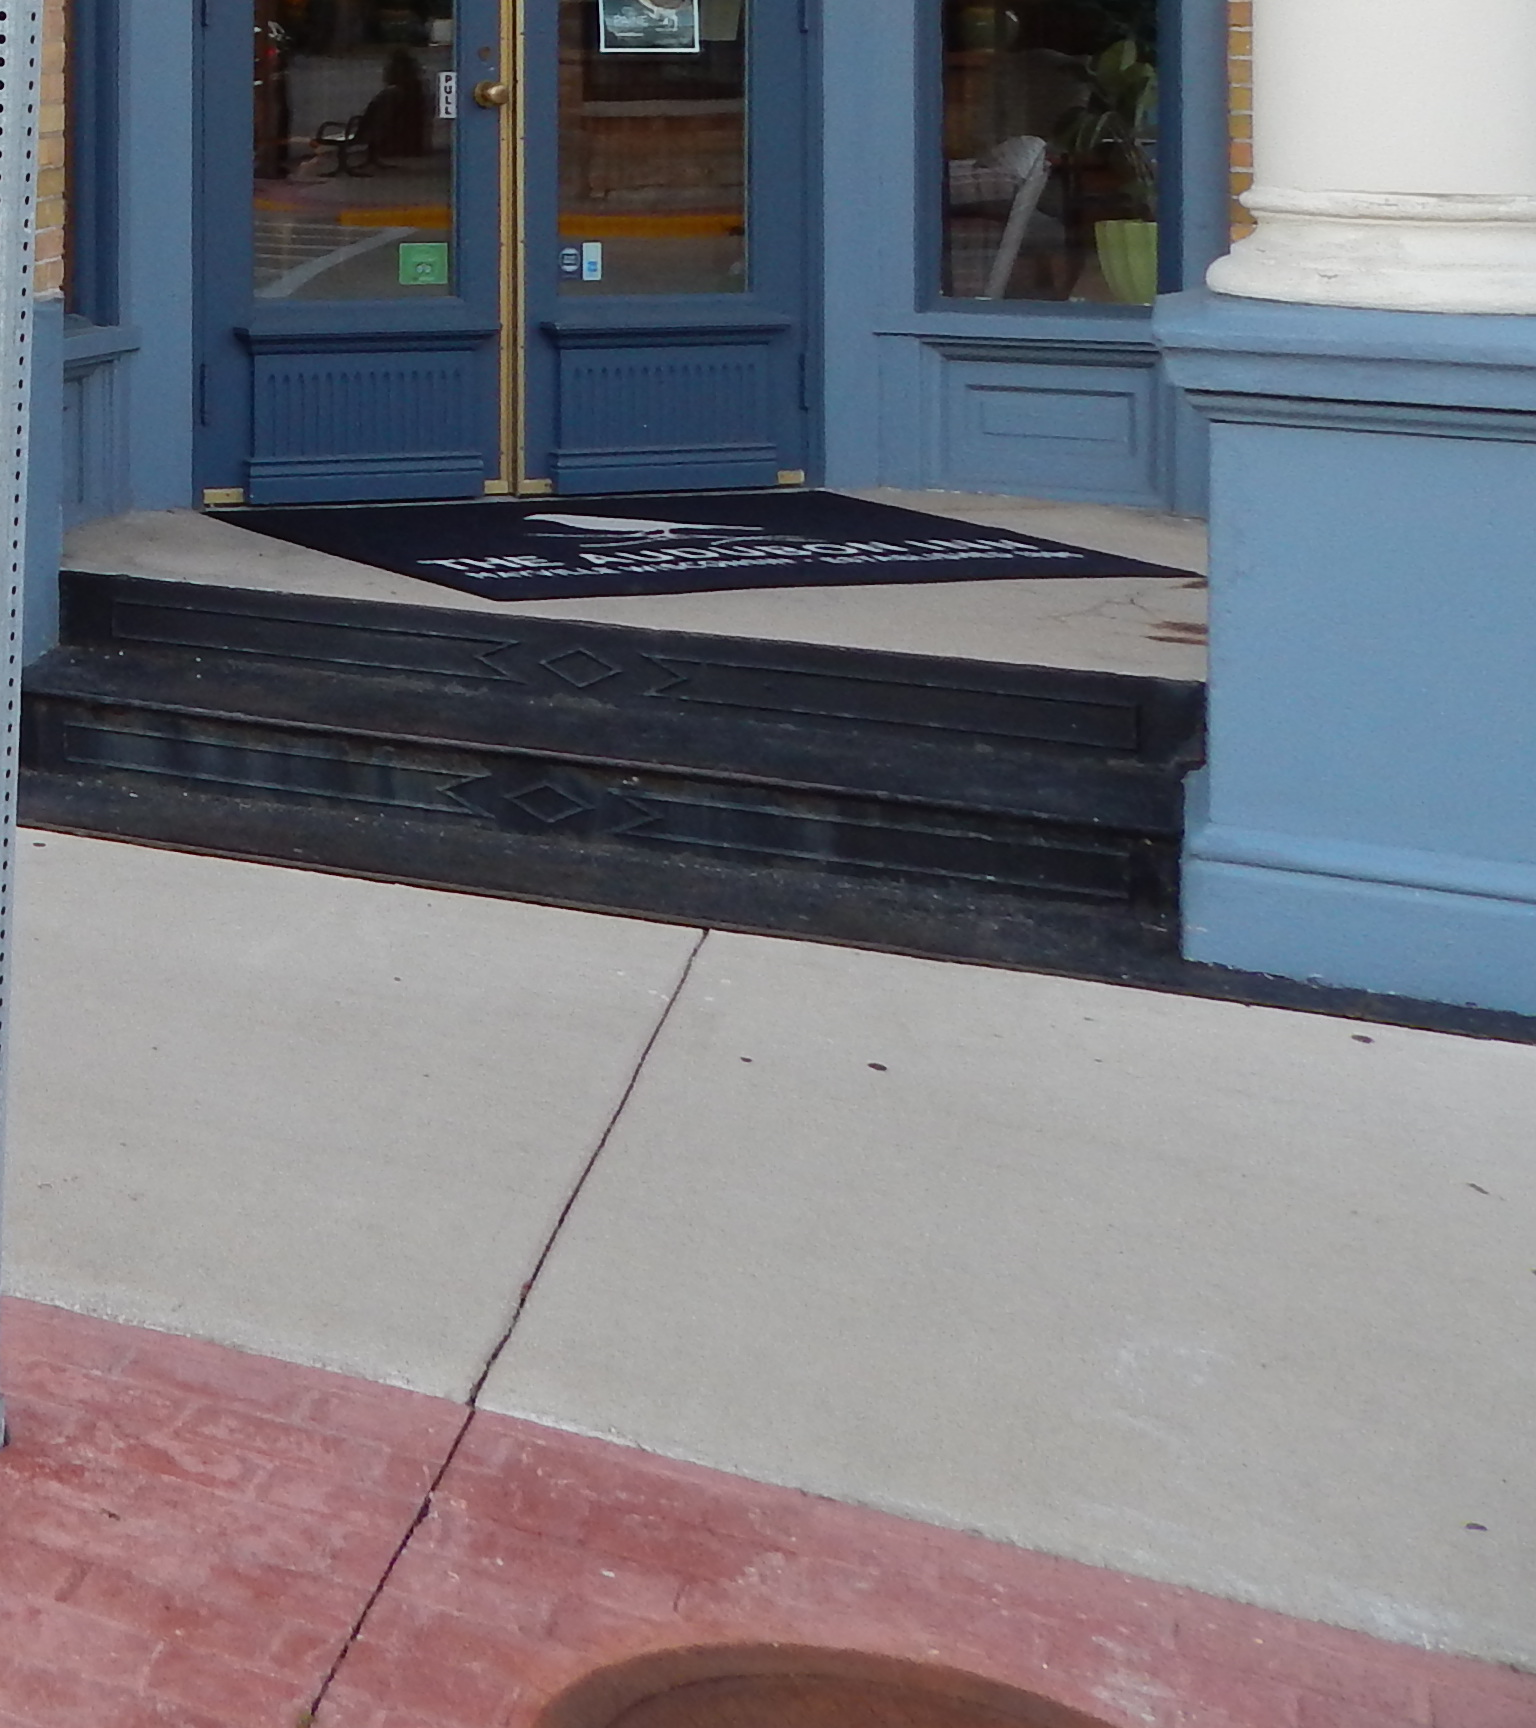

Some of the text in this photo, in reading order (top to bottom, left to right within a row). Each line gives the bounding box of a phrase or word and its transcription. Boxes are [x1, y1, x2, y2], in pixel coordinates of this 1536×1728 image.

[444, 74, 453, 115] PULL
[417, 539, 1040, 570] THE AUDUBON INN
